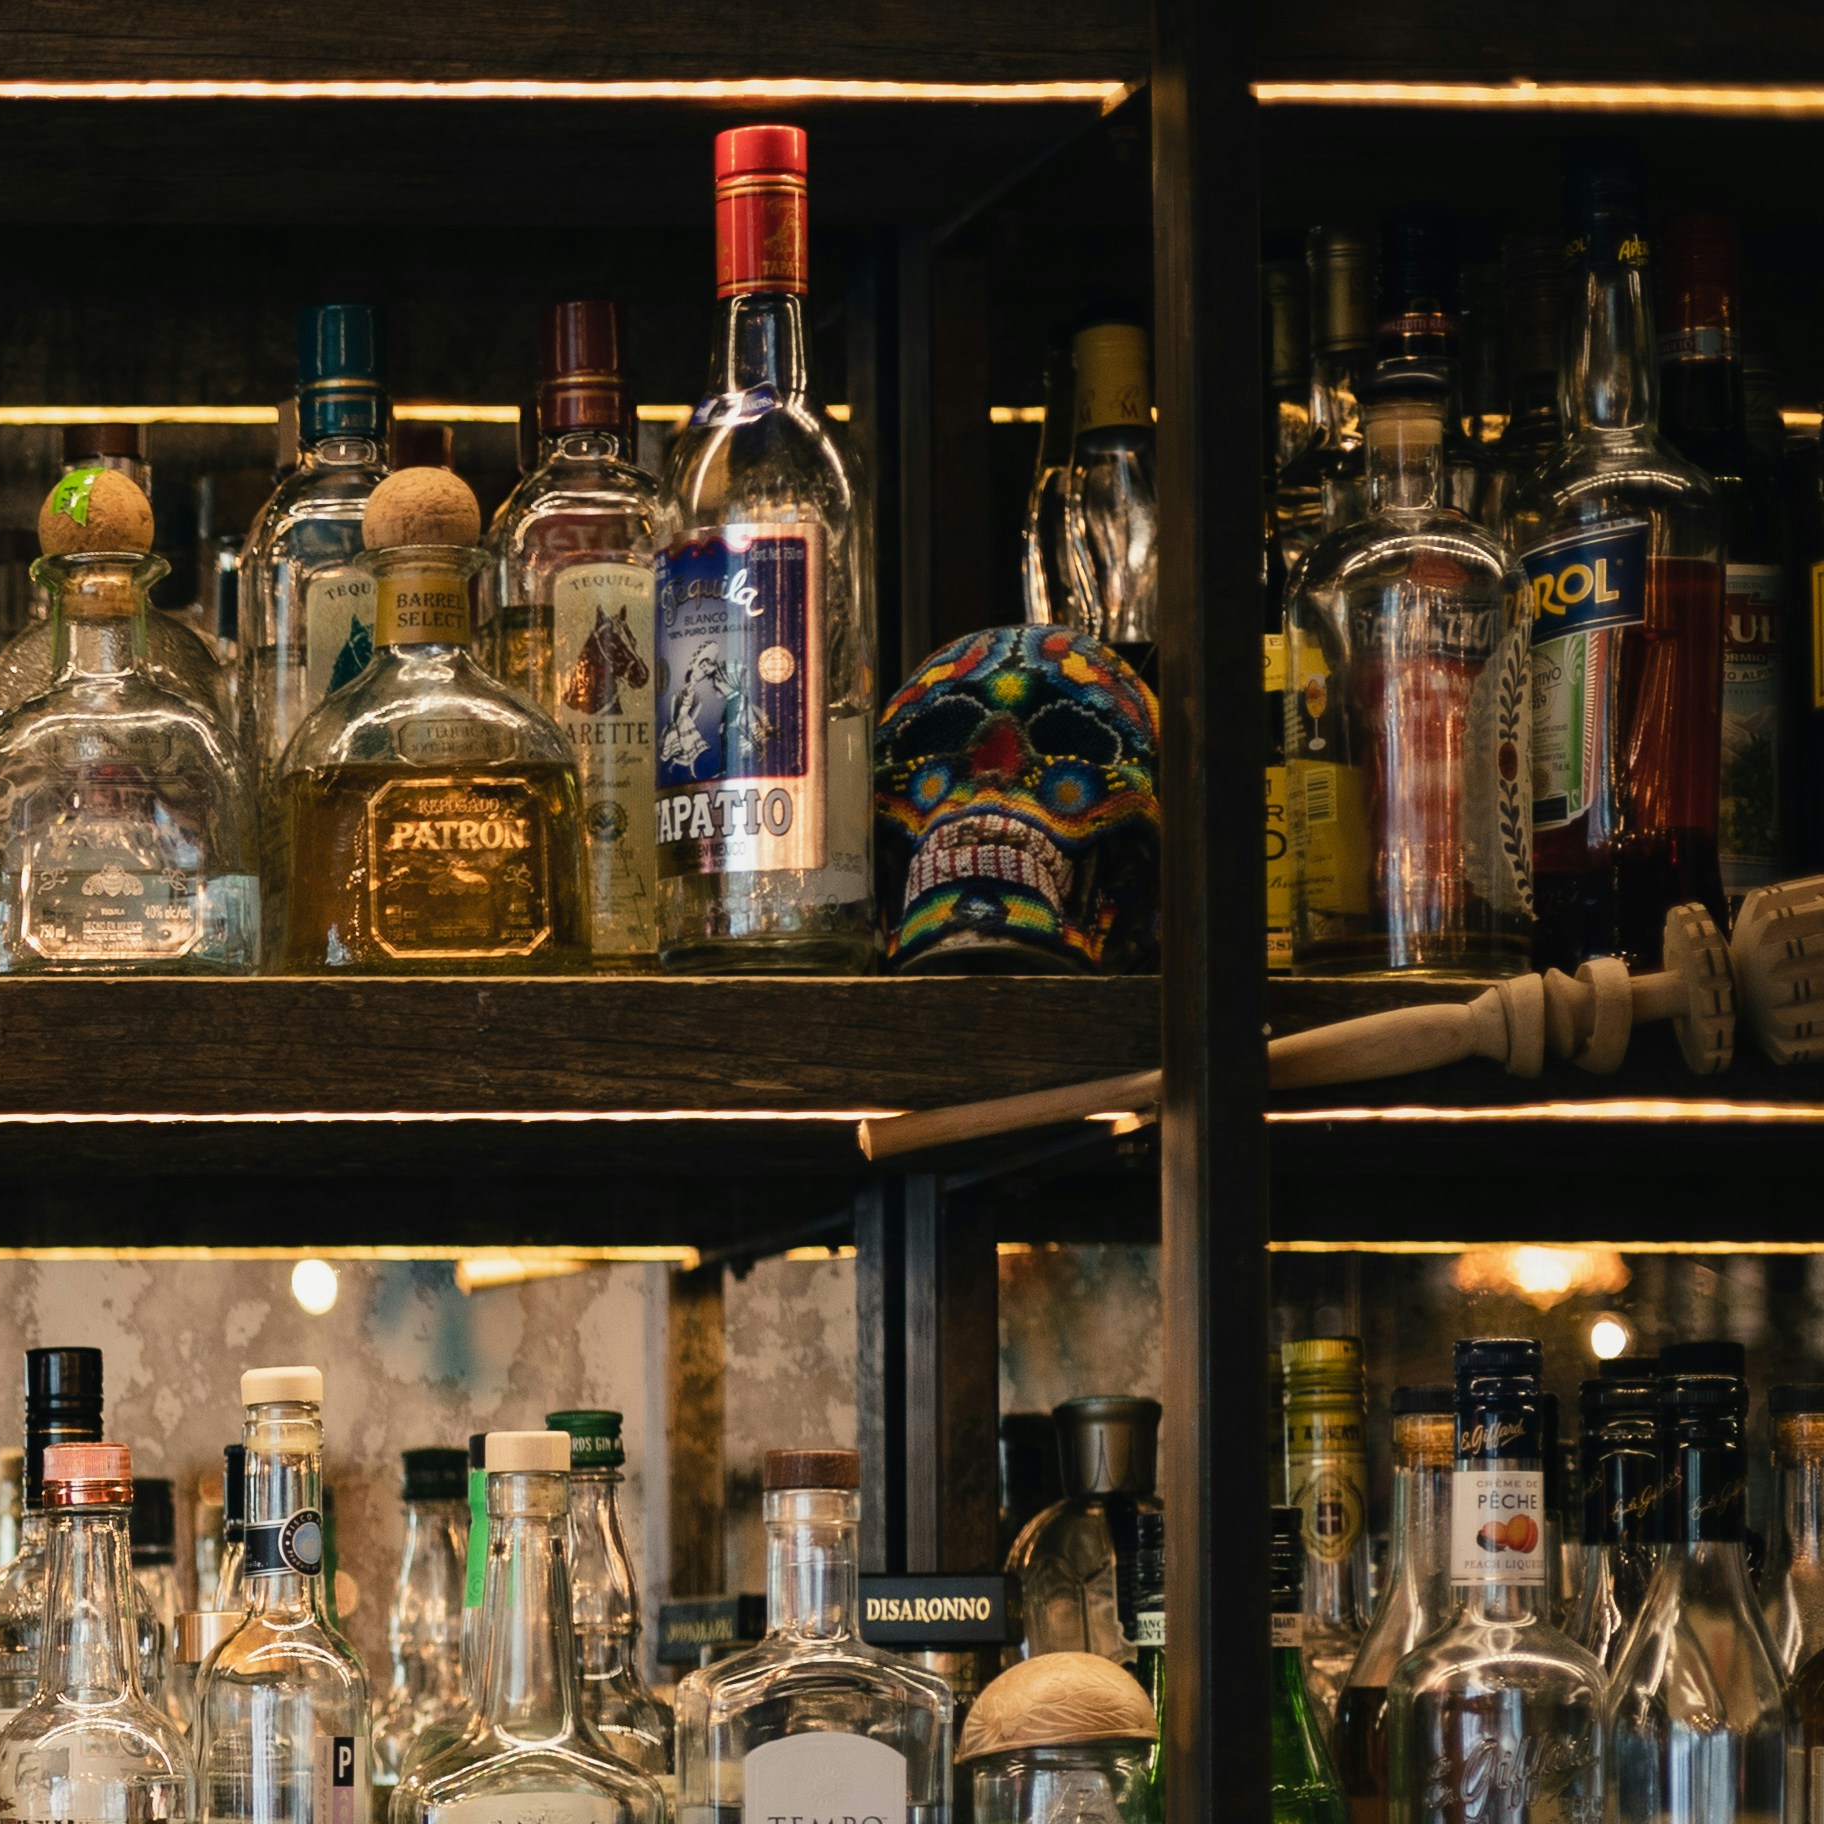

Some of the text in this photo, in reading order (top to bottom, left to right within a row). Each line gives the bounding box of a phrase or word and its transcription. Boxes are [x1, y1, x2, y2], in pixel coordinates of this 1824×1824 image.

[570, 574, 646, 593] TEQUILA
[396, 592, 465, 609] BARREL
[660, 568, 765, 628] Tequila
[397, 612, 465, 628] SELECT
[684, 611, 728, 625] BLANCO
[564, 722, 649, 745] ARETTE
[419, 798, 500, 814] REPOSADO
[392, 810, 531, 851] PATRÓN
[1477, 1488, 1538, 1513] PÊCHE
[866, 1596, 991, 1623] DISARONNO
